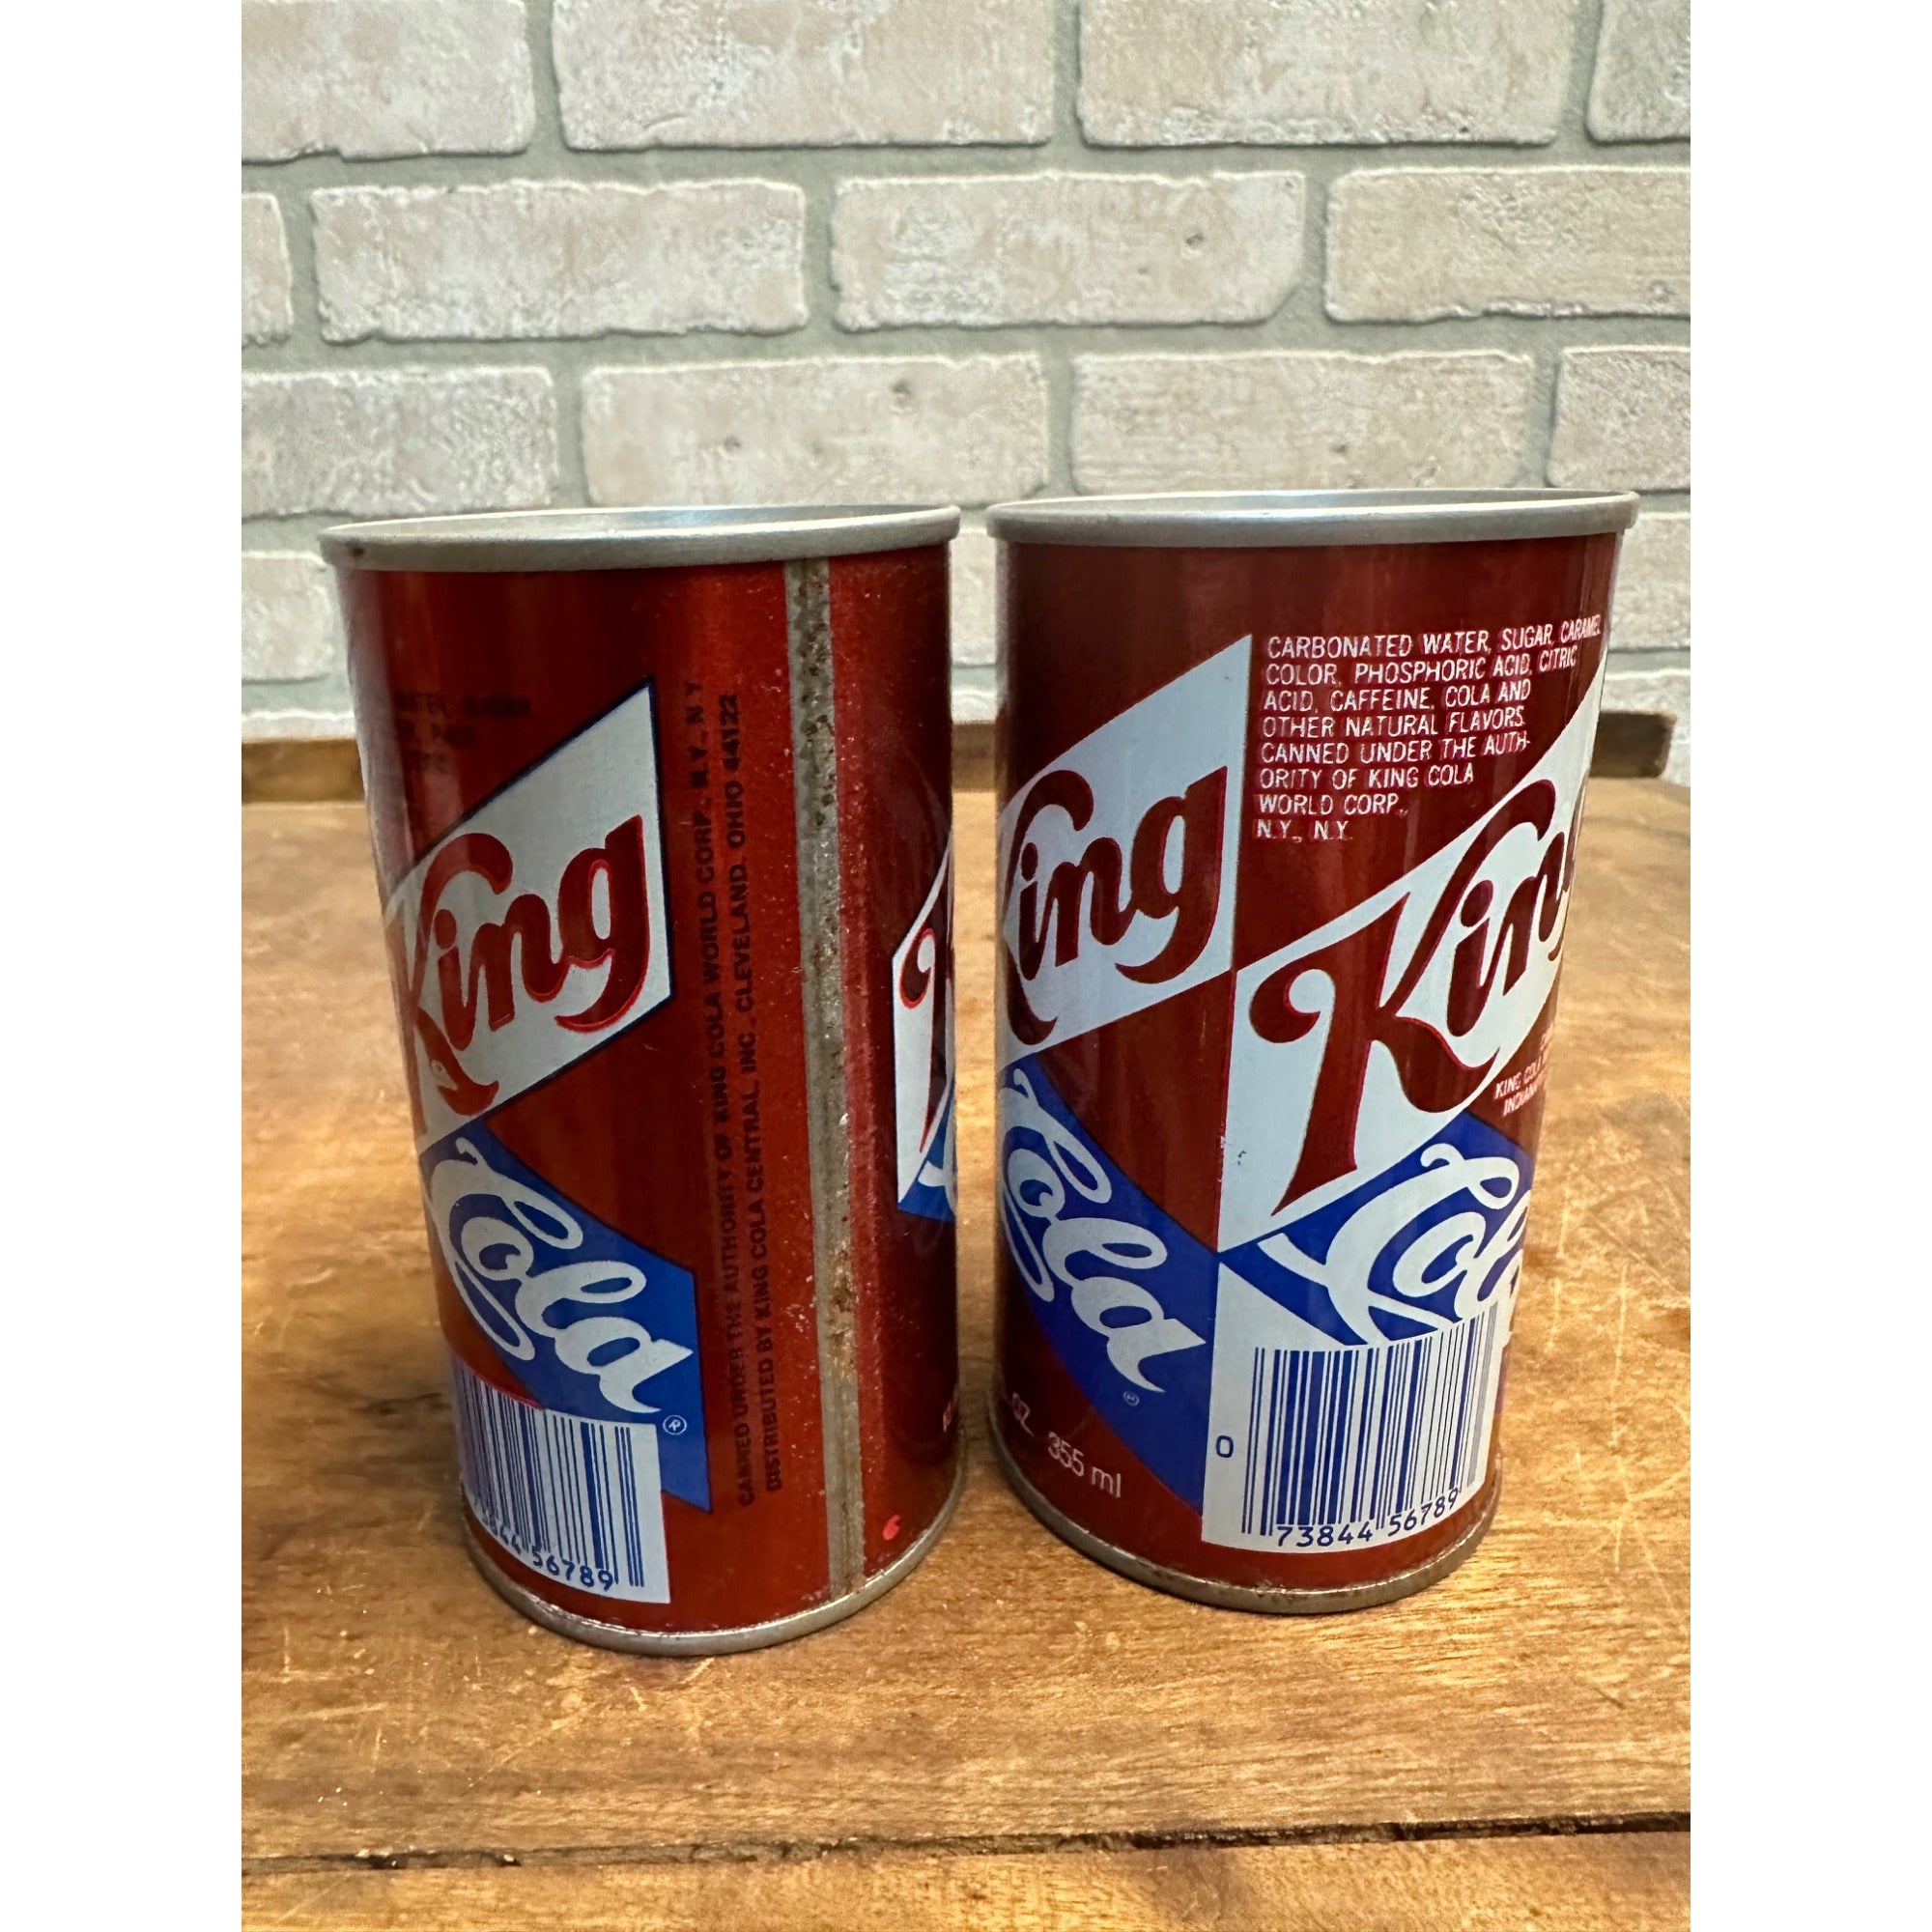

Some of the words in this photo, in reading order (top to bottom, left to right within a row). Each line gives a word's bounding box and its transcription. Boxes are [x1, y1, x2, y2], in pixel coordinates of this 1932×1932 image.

[1266, 664, 1342, 686] COLOR,
[1355, 657, 1486, 684] PHOSPHORIC
[1540, 645, 1577, 671] CITRIC
[1268, 635, 1412, 658] CARBONATED
[1423, 630, 1491, 655] WATER,
[1264, 691, 1318, 713] ACID,
[1446, 683, 1490, 707] COLA
[1498, 679, 1531, 701] AND
[719, 695, 740, 772] 44122
[1262, 742, 1350, 764] CANNED
[1360, 740, 1433, 763] UNDER
[1442, 737, 1477, 759] THE
[1484, 730, 1531, 755] AUTH-
[1264, 717, 1335, 738] OTHER
[1346, 714, 1438, 737] NATURAL
[1259, 794, 1333, 815] WORLD
[1260, 768, 1322, 789] ORITY
[1332, 768, 1359, 790] OF
[1369, 767, 1418, 788] KING
[1429, 762, 1473, 786] COLA
[724, 781, 746, 849] OHIO
[697, 892, 721, 984] WORLD
[703, 992, 724, 1058] COLA
[1249, 779, 1578, 1215] Kin
[709, 1065, 729, 1124] KING
[713, 1134, 732, 1160] OF
[716, 1170, 740, 1293] AUTHORITY
[748, 1198, 768, 1260] COLA
[425, 1137, 694, 1413] Cola
[752, 1265, 772, 1320] KING
[724, 1302, 742, 1342] THE
[757, 1327, 774, 1351] BY
[728, 1348, 752, 1418] UNDER
[759, 1359, 781, 1492] DISTRIBUTED
[1215, 1435, 1234, 1459] 0
[734, 1423, 754, 1507] CANNED
[1047, 1431, 1085, 1477] 355
[1091, 1466, 1122, 1497] ml
[1276, 1521, 1373, 1547] 73844
[1387, 1487, 1460, 1536] 56789
[532, 1545, 613, 1591] 56789
